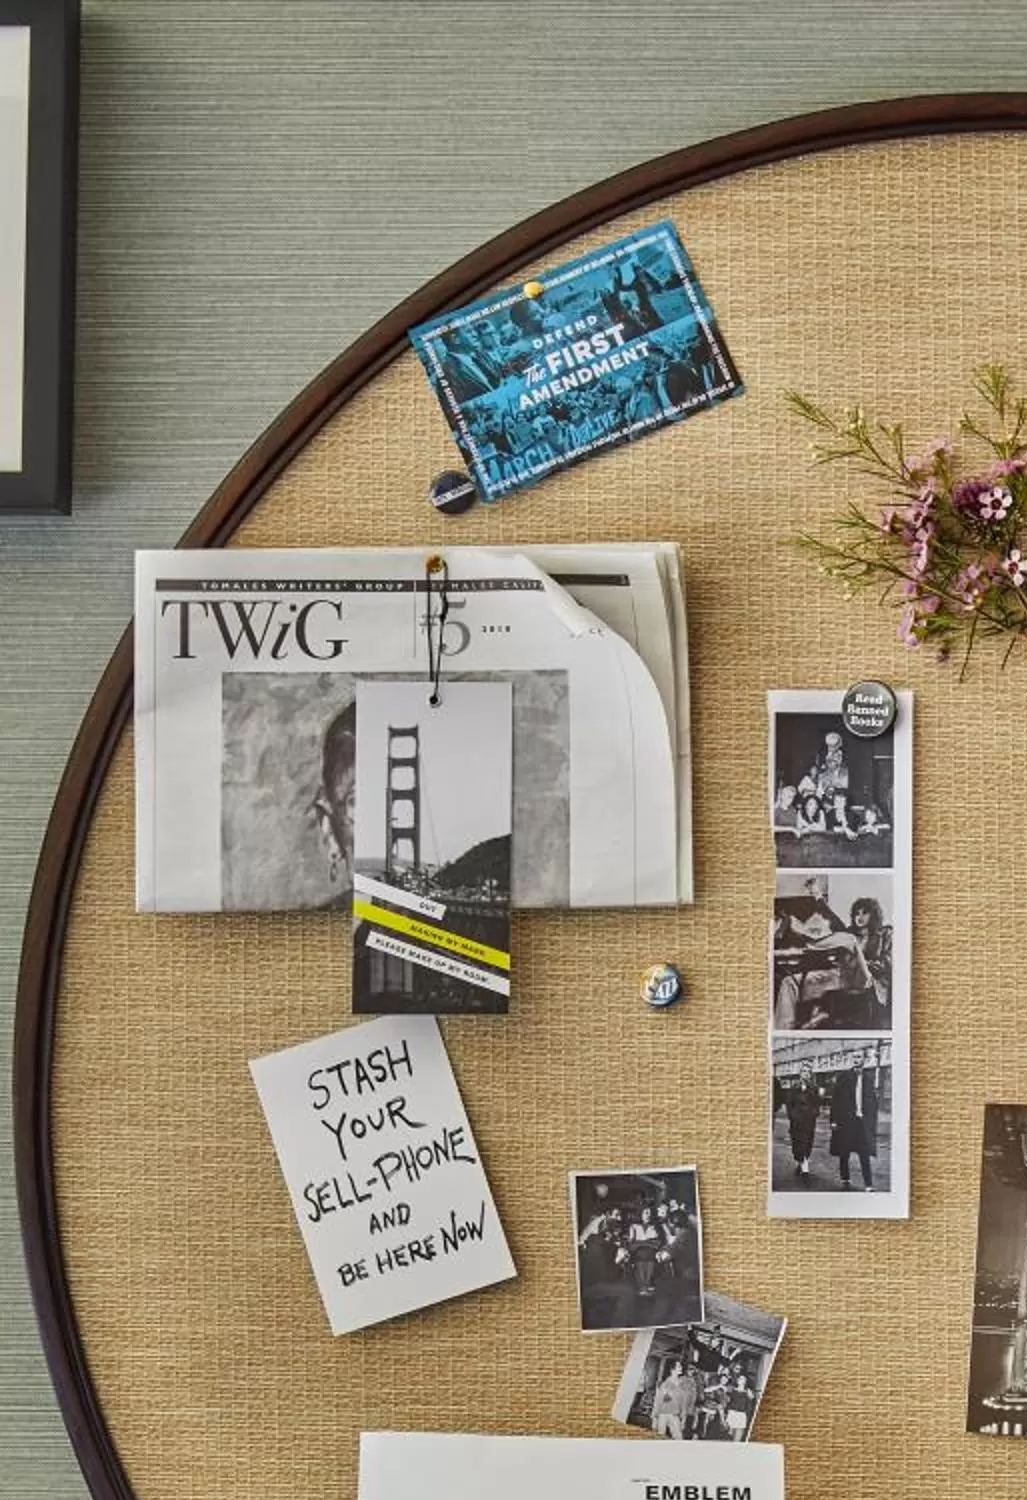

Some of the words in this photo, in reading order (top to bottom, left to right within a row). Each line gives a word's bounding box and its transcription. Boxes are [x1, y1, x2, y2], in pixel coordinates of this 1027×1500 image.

[522, 362, 547, 387] The
[545, 323, 625, 375] FIRST
[532, 315, 597, 350] DEFEND
[519, 341, 649, 410] AMENDMENT
[202, 581, 268, 590] TOMALES
[355, 581, 404, 591] GROUP
[161, 599, 349, 660] TWiG
[308, 1040, 413, 1110] STASH
[321, 1096, 427, 1161] YOUR
[303, 1127, 477, 1223] SELL-PHONE
[368, 1203, 411, 1235] AND
[337, 1260, 369, 1287] BE
[376, 1233, 438, 1275] HERE
